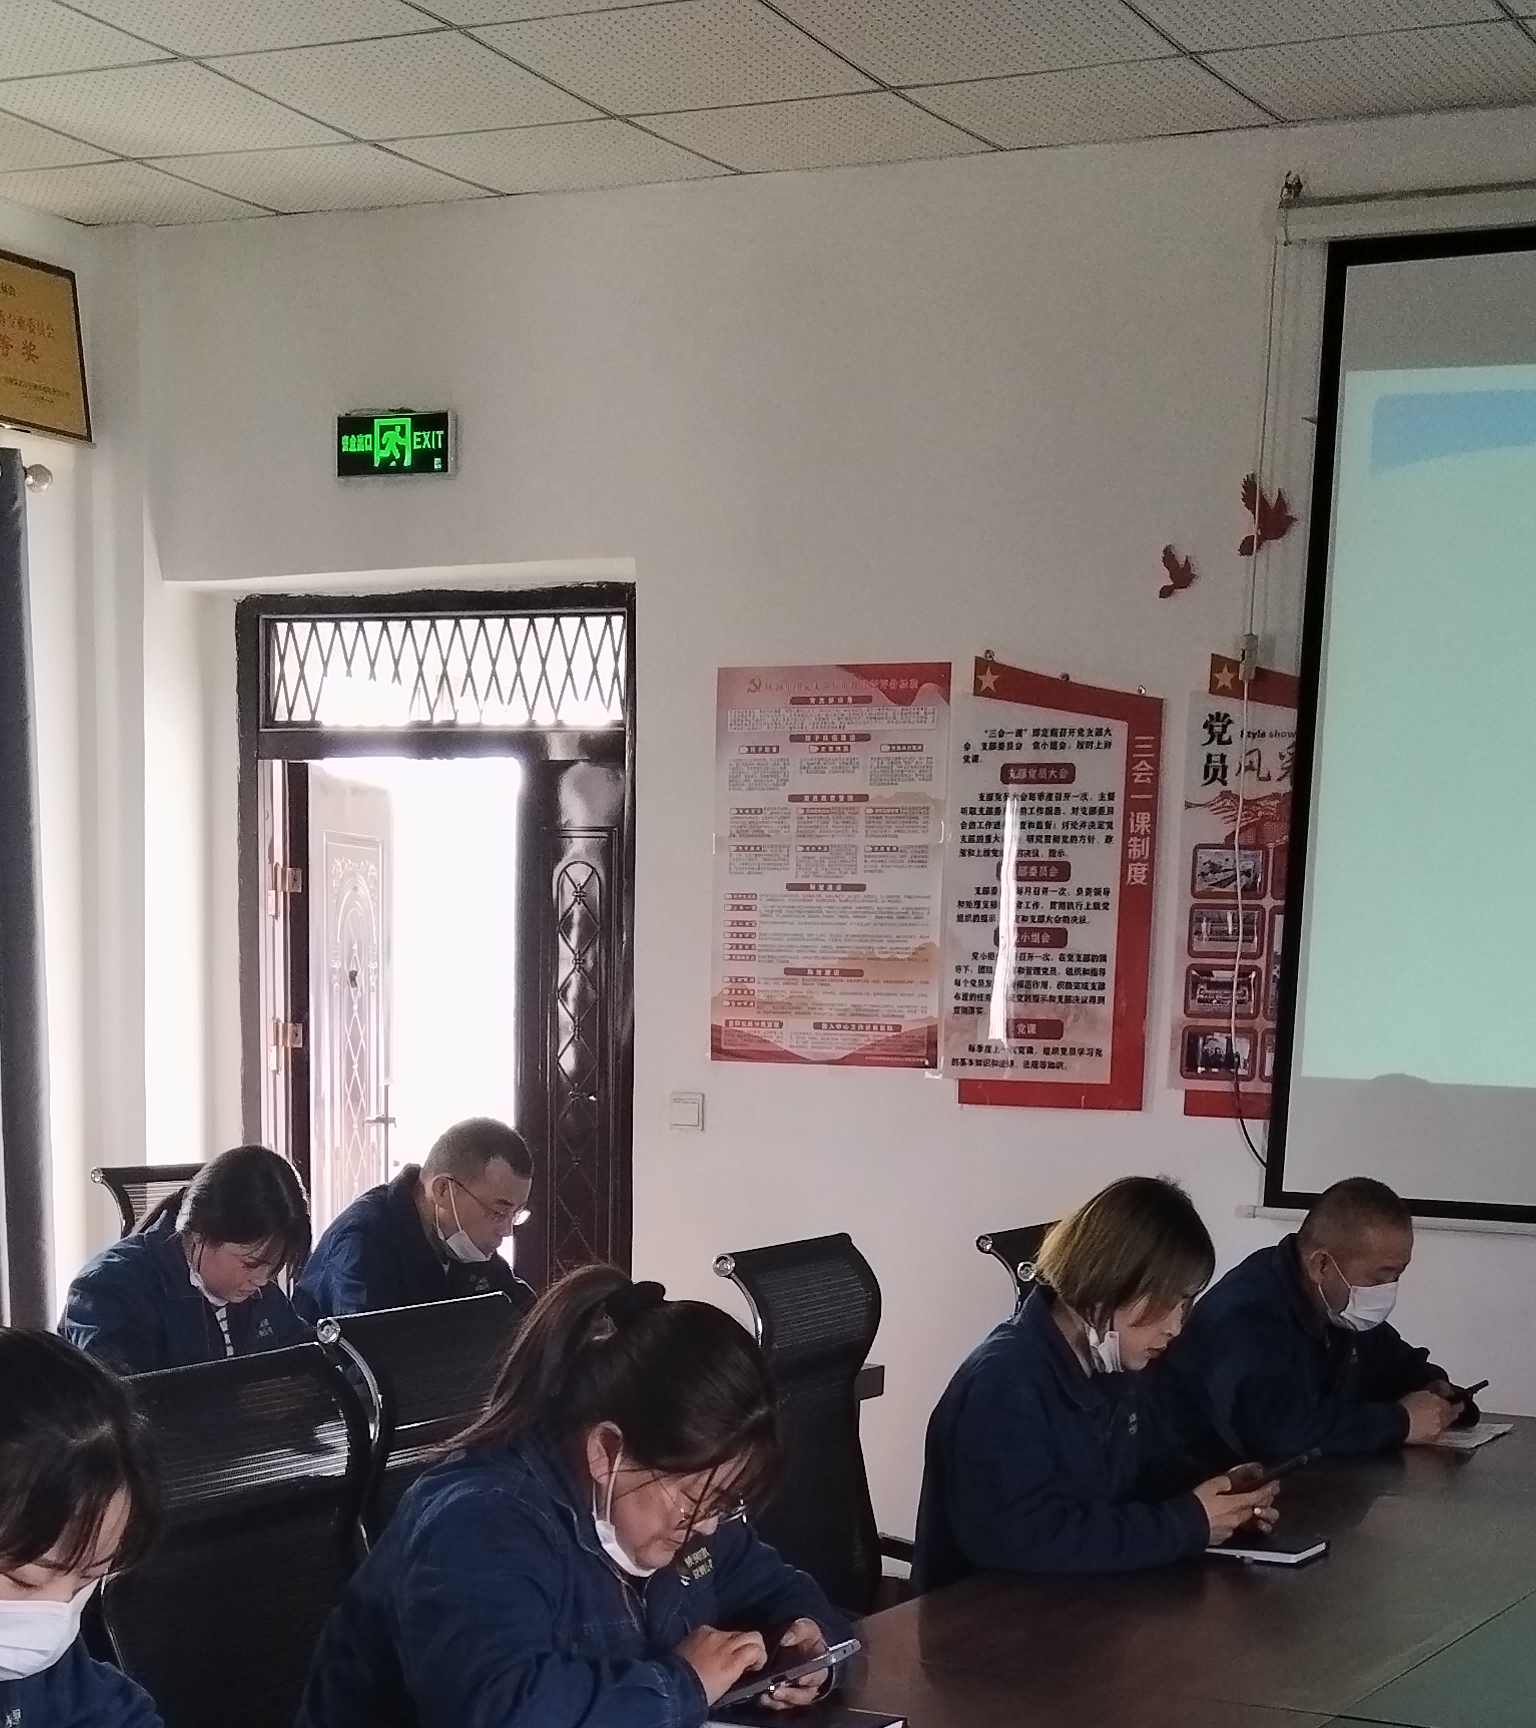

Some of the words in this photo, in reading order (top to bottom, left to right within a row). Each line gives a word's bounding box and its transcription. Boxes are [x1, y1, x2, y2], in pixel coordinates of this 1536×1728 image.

[413, 430, 444, 450] EXIT
[1201, 711, 1235, 788] 党员
[1008, 767, 1069, 779] 支部党员大会
[1124, 733, 1156, 887] 三会一课制度
[1016, 932, 1051, 944] 小组会
